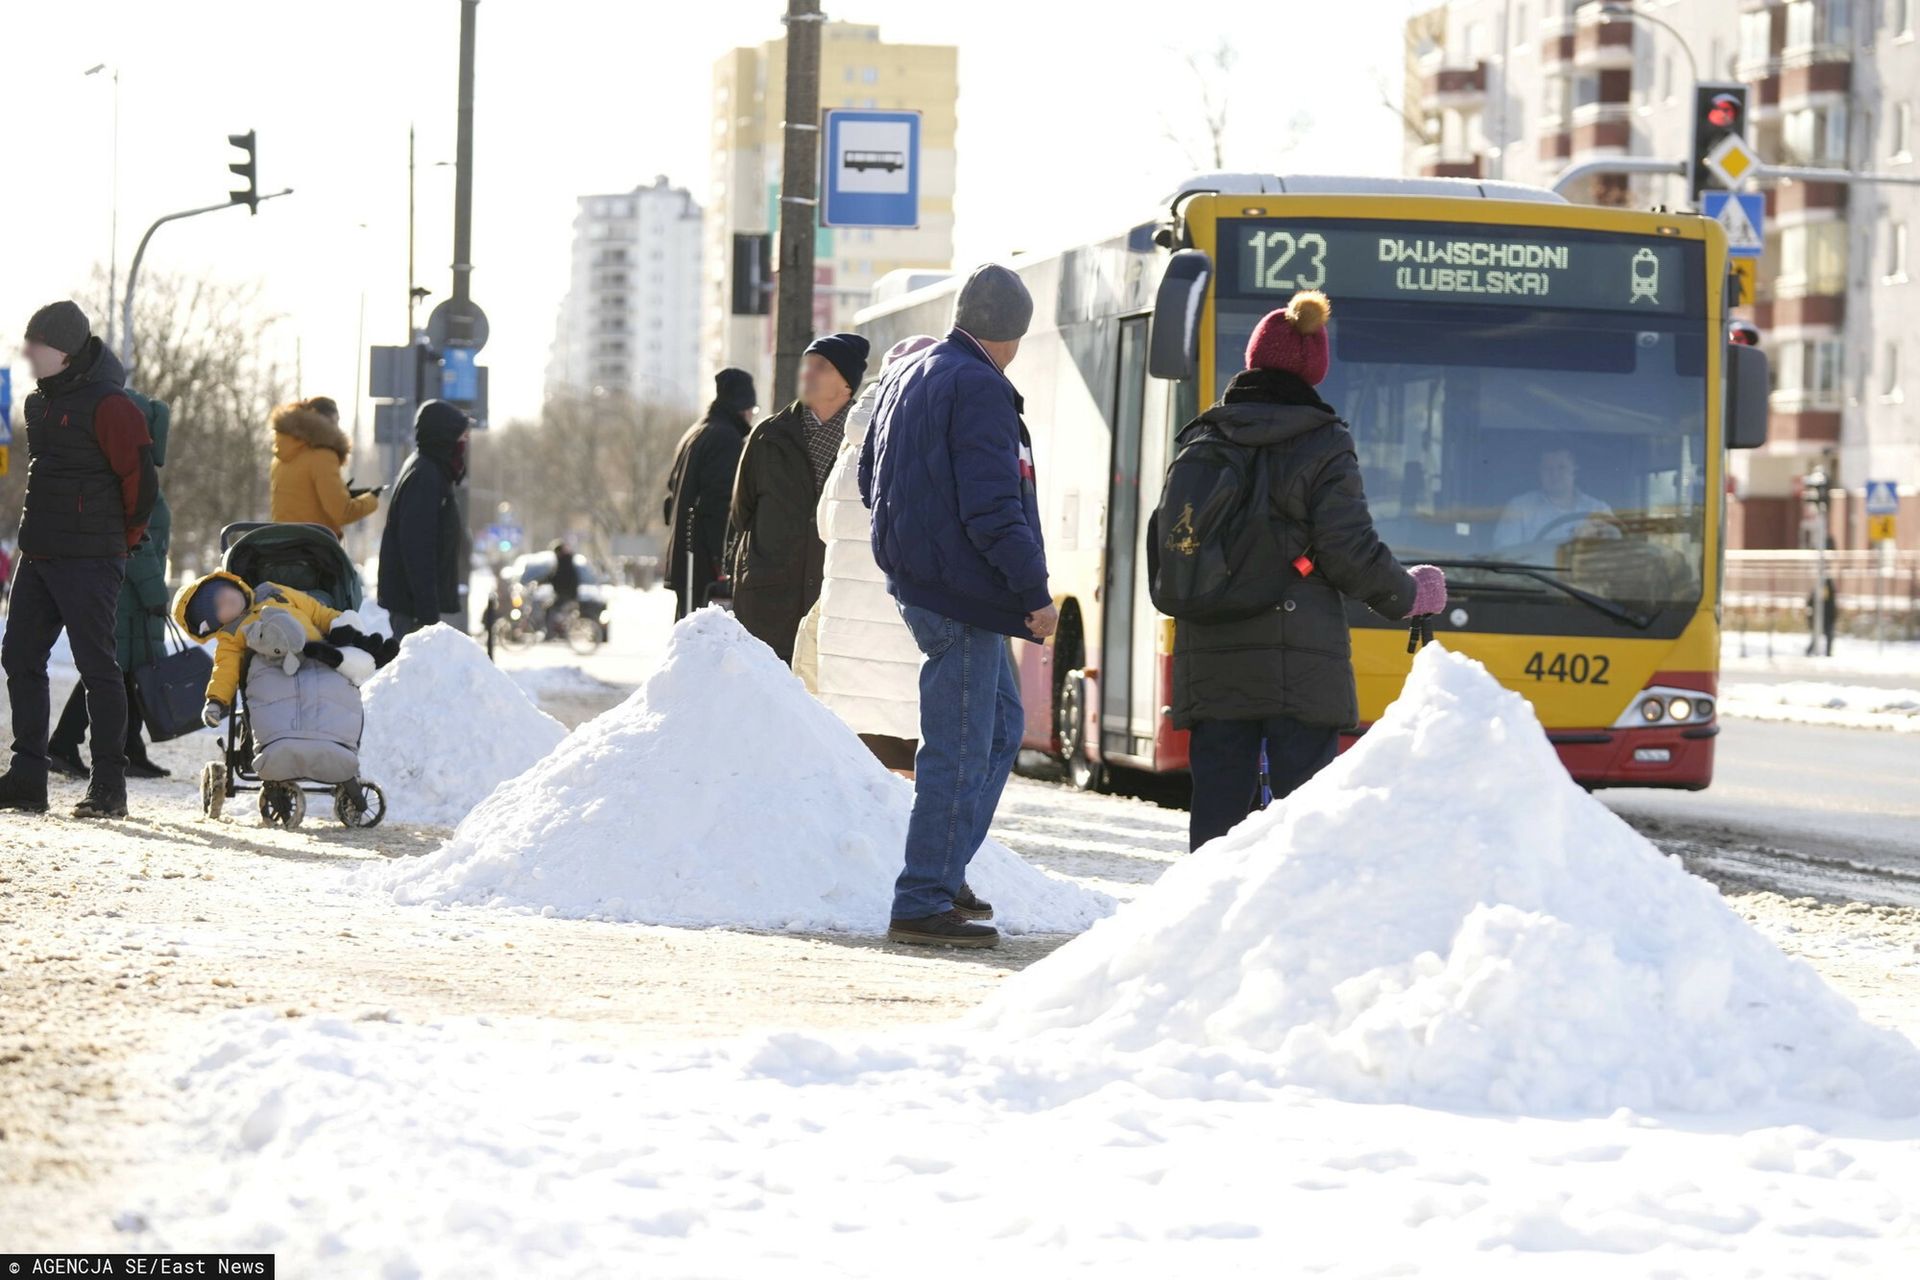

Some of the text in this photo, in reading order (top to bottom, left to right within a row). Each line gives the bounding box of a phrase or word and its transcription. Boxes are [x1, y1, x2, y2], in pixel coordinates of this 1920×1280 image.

[1248, 230, 1327, 289] 123
[1379, 238, 1569, 270] DW.WSCHODNI
[1396, 266, 1550, 296] (LUBELSKA)
[1524, 651, 1610, 685] 4402
